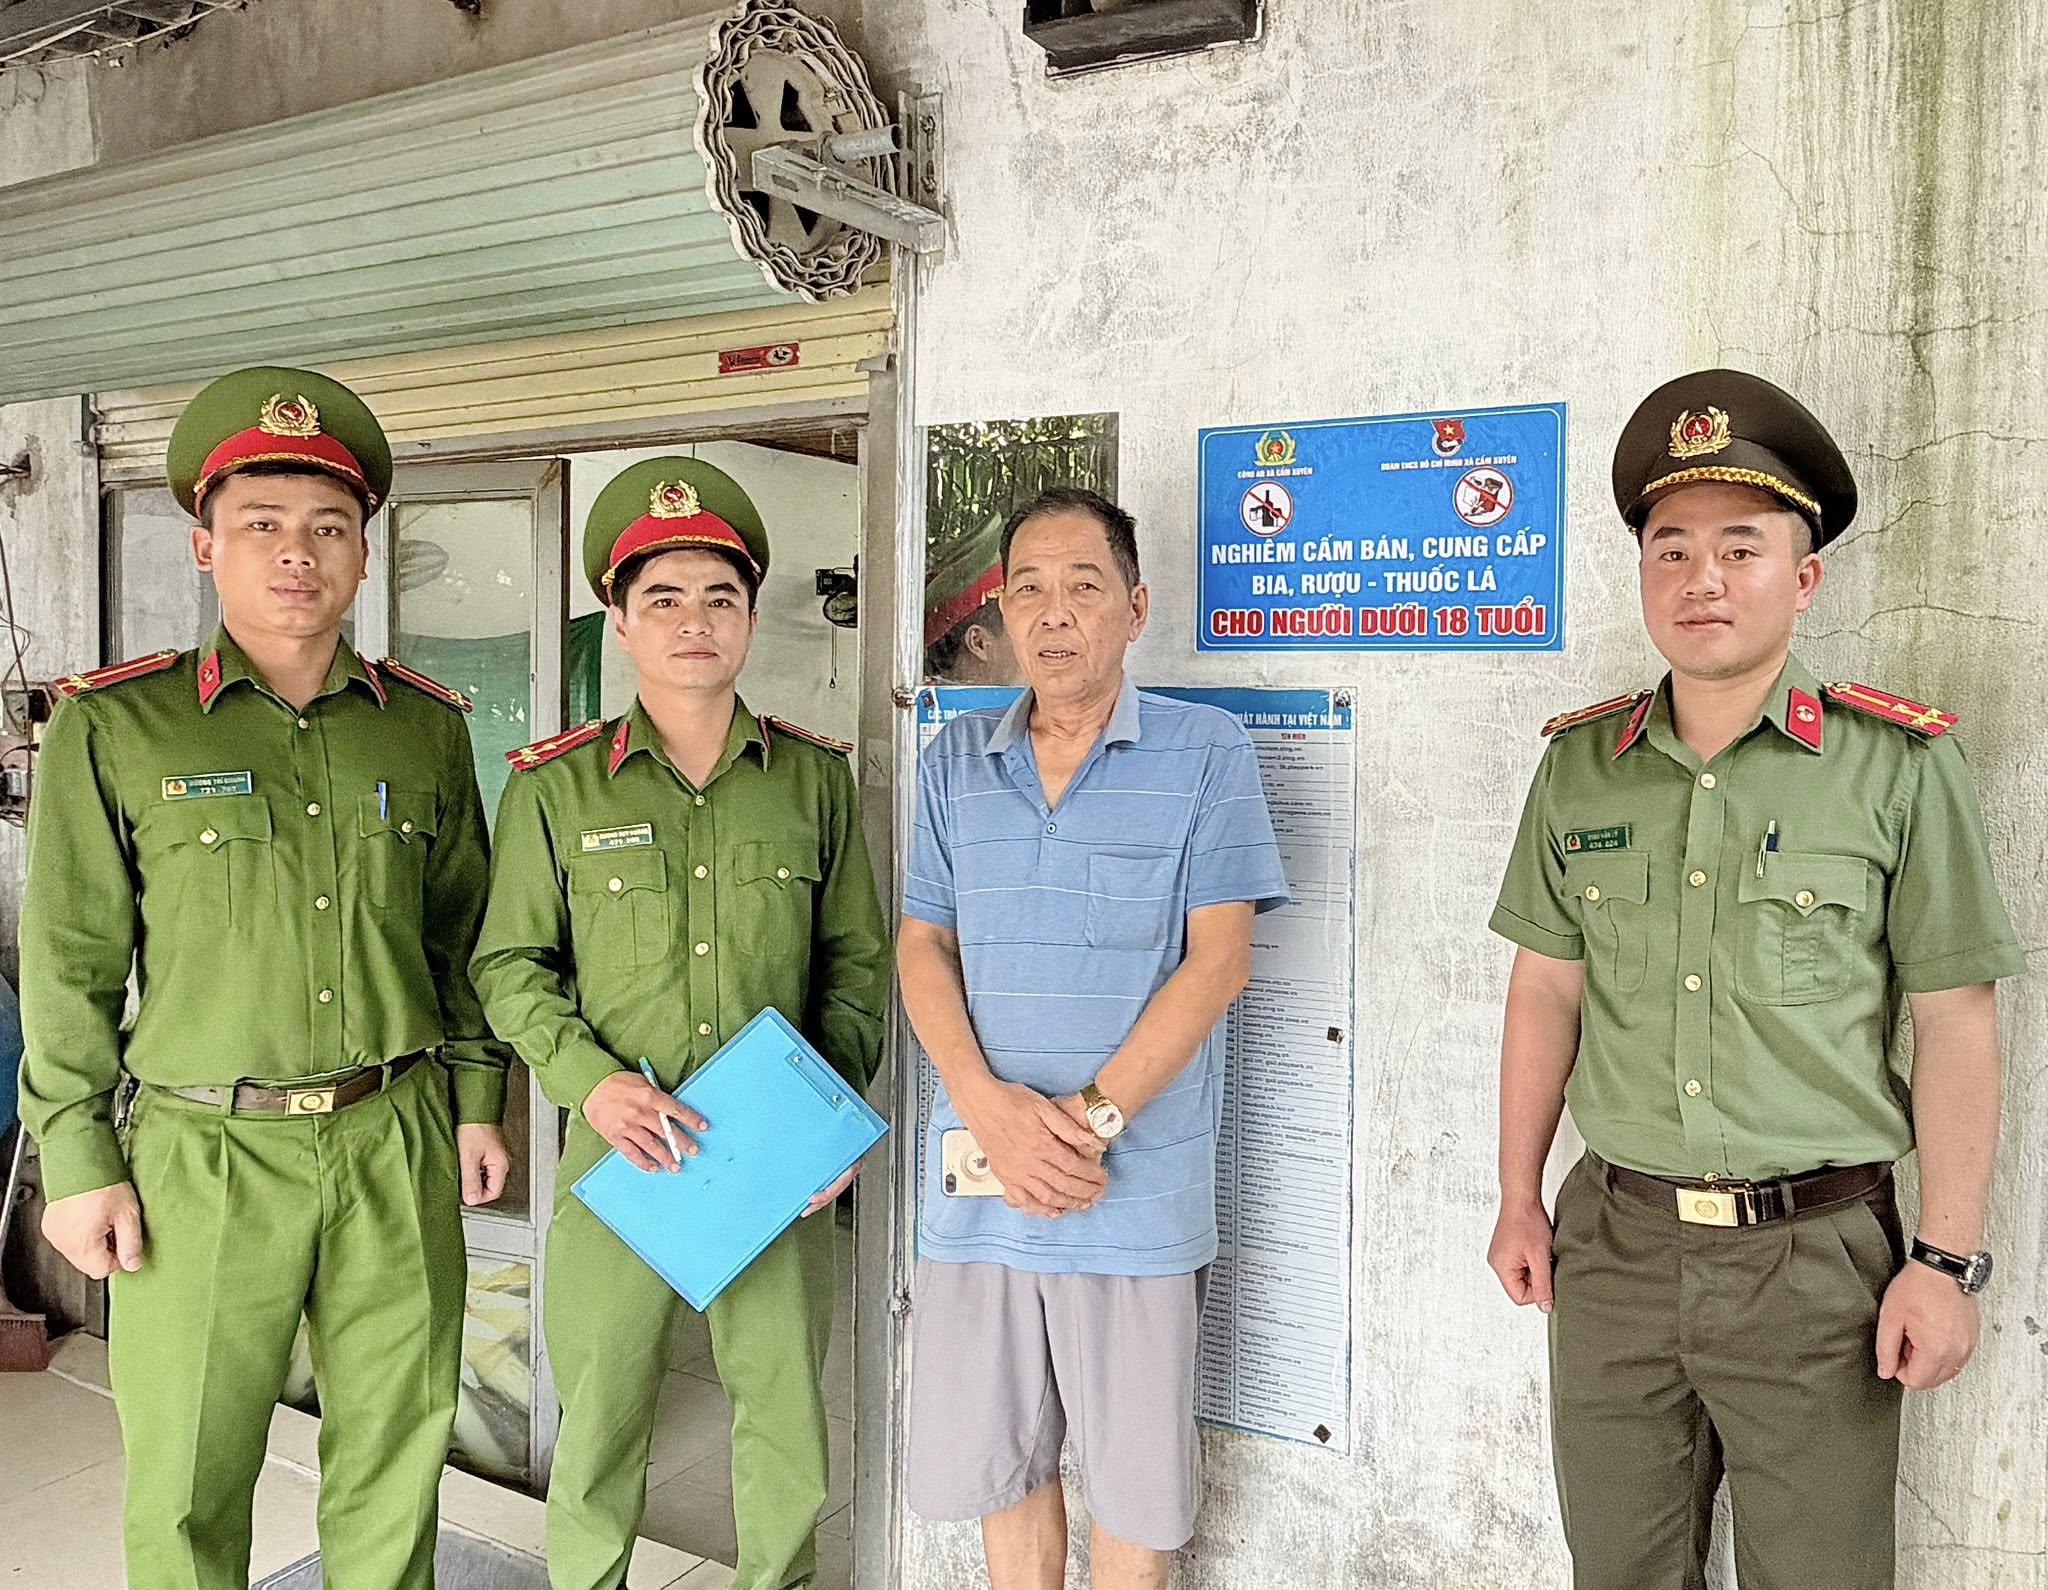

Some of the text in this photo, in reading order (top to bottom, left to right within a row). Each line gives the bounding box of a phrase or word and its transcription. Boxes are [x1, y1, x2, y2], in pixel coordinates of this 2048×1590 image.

[1211, 526, 1547, 565] NGHIÊM CẤM BÁN, CUNG CẤP
[1252, 574, 1294, 597] BIA,
[1301, 571, 1361, 598] RƯỢU
[1383, 563, 1460, 593] THUỐC
[1467, 565, 1497, 591] LÁ
[1211, 595, 1547, 637] CHO NGƯỜI DƯỚI 18 TUỔI
